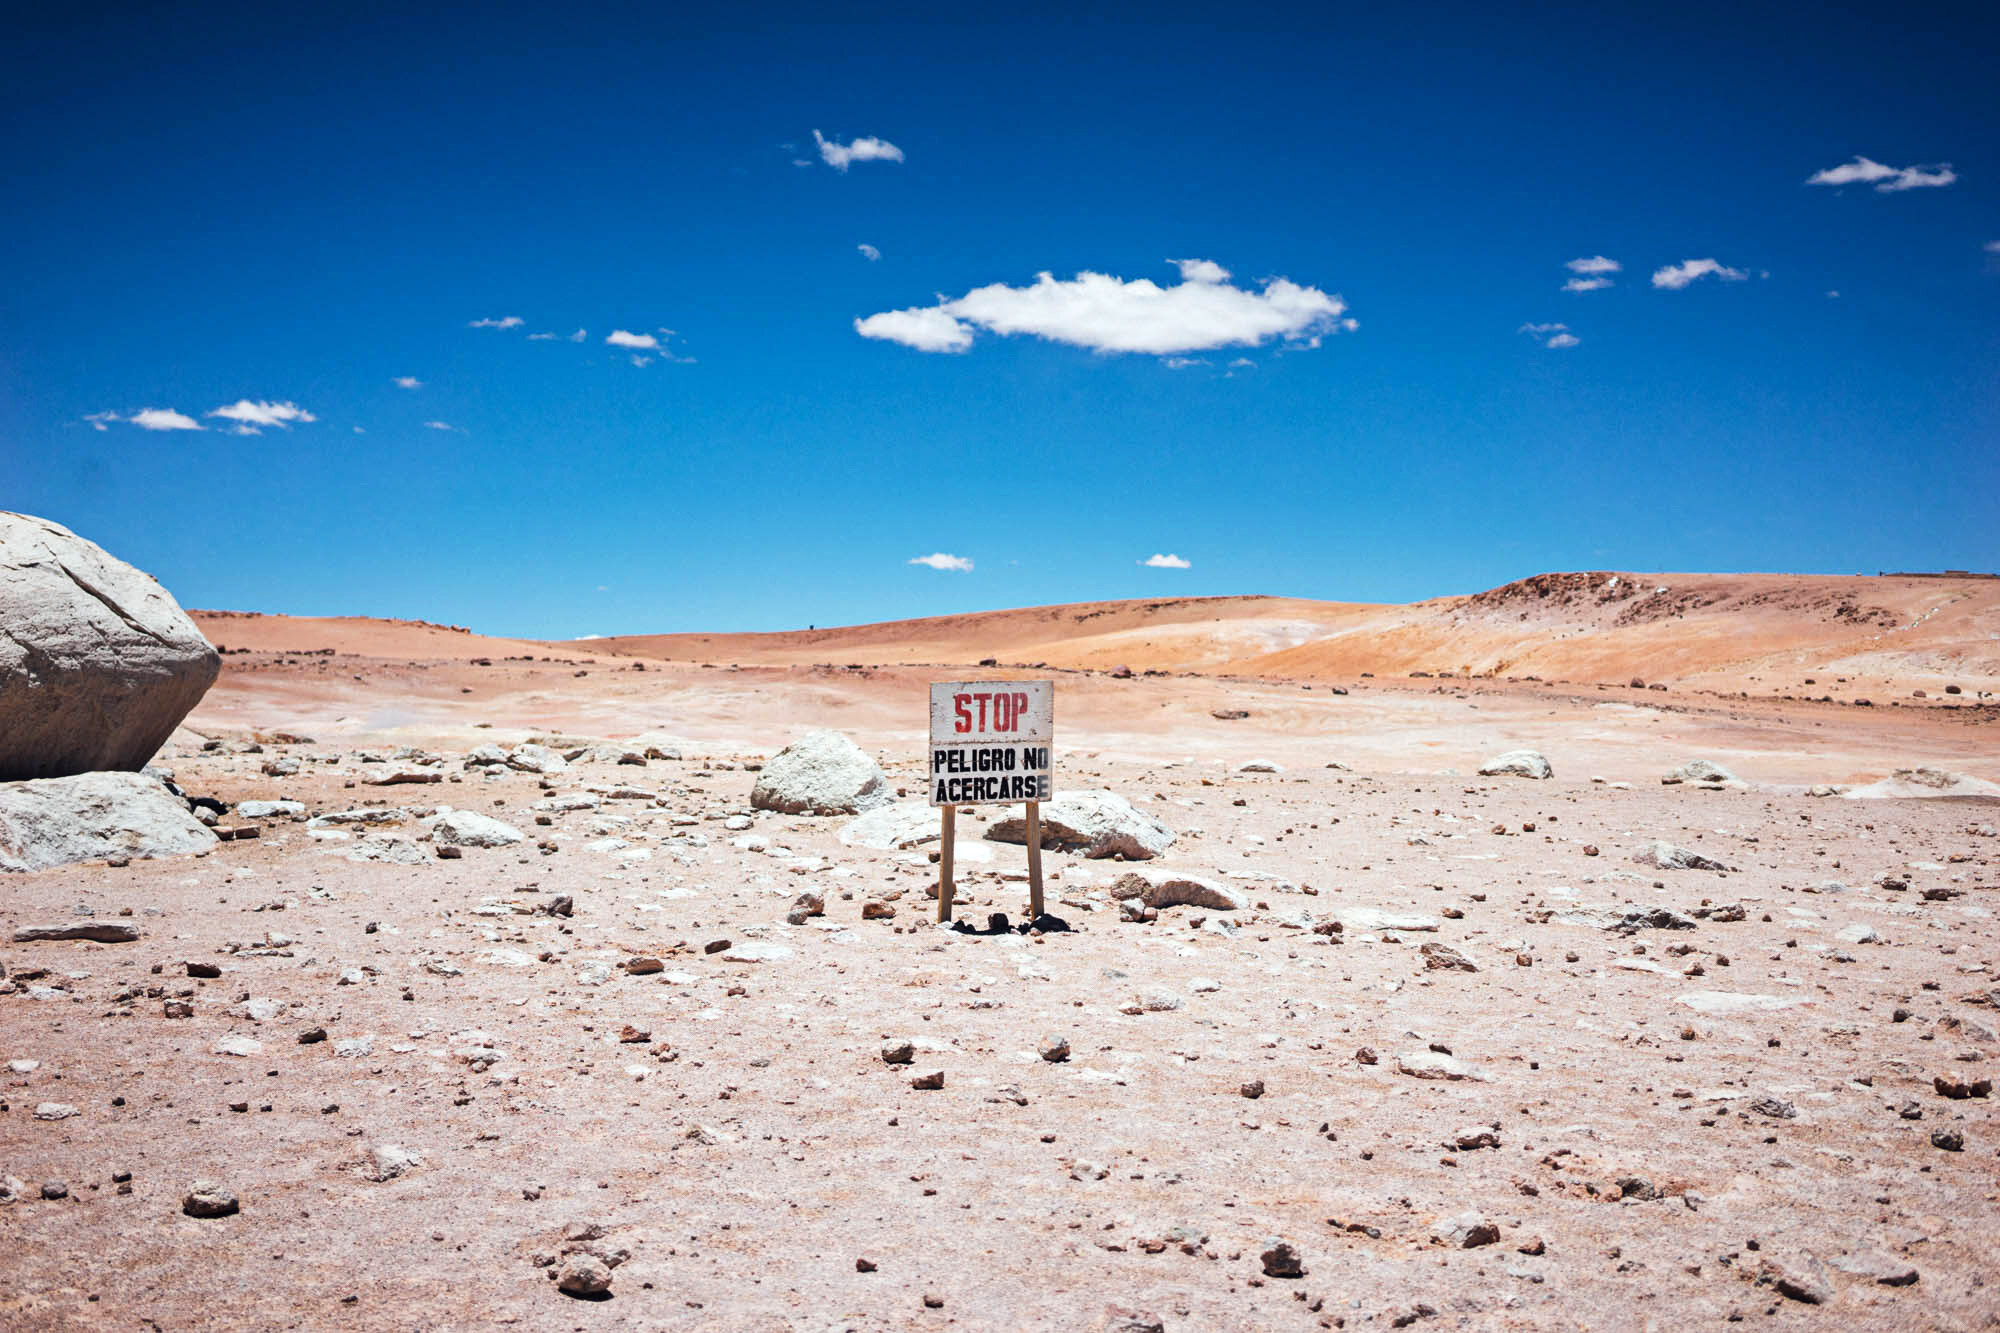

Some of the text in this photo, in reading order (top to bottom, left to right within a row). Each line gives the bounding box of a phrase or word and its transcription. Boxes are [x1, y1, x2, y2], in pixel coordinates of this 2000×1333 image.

[954, 693, 1028, 733] STOP
[934, 747, 1048, 773] PELIGRO NO
[936, 775, 1048, 802] ACERCARSE
